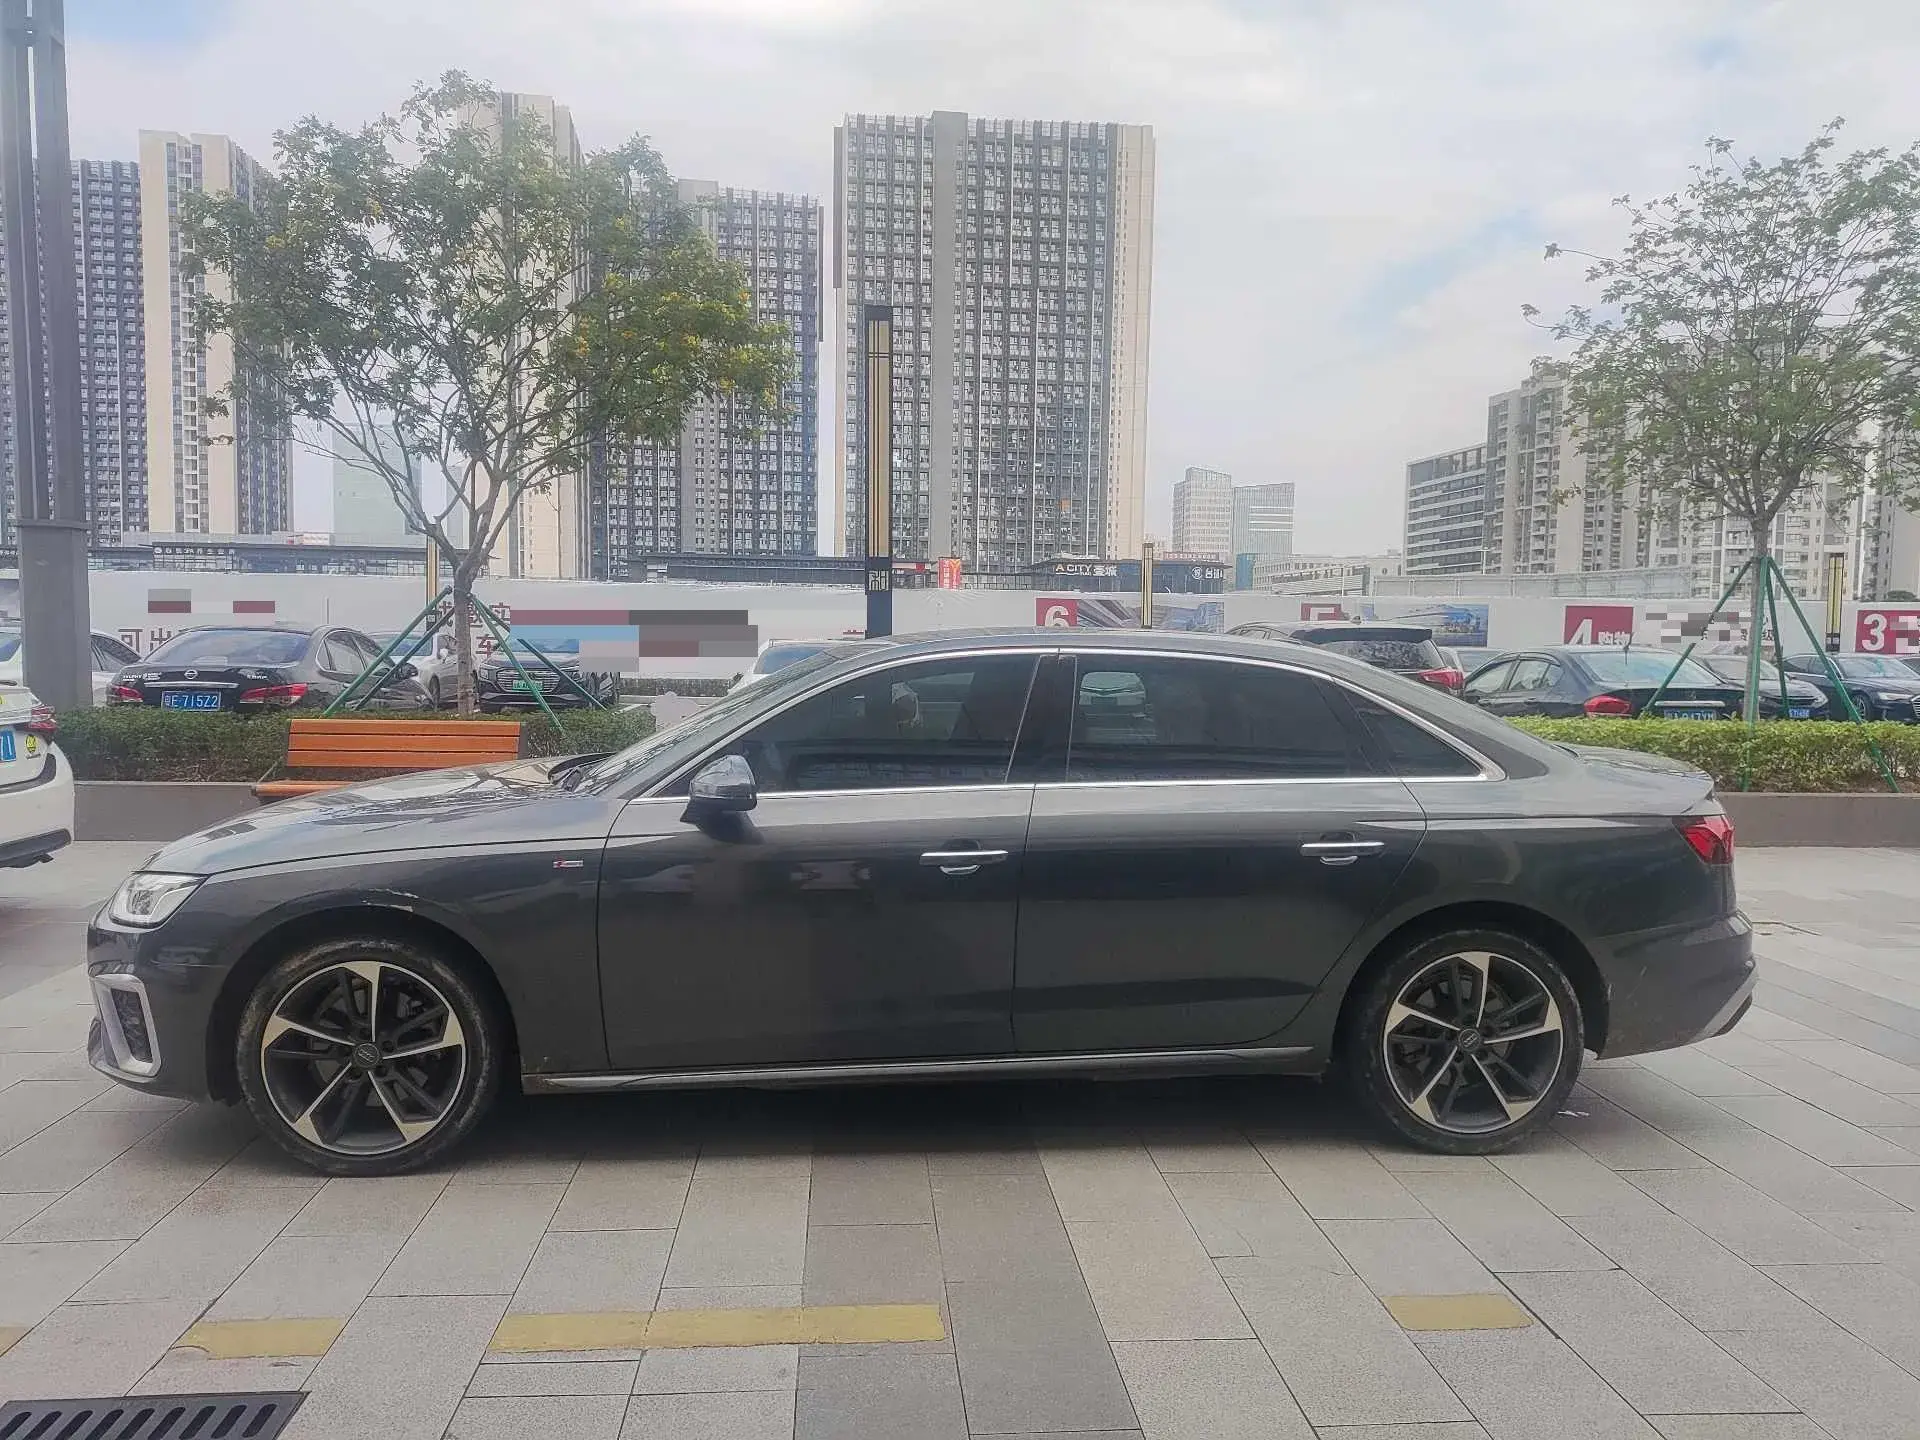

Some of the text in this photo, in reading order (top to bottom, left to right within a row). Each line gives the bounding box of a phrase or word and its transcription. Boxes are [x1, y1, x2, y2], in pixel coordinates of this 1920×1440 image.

[1067, 564, 1092, 573] CITY
[1045, 605, 1070, 627] 6
[1568, 618, 1592, 645] 4
[1861, 613, 1888, 651] 3
